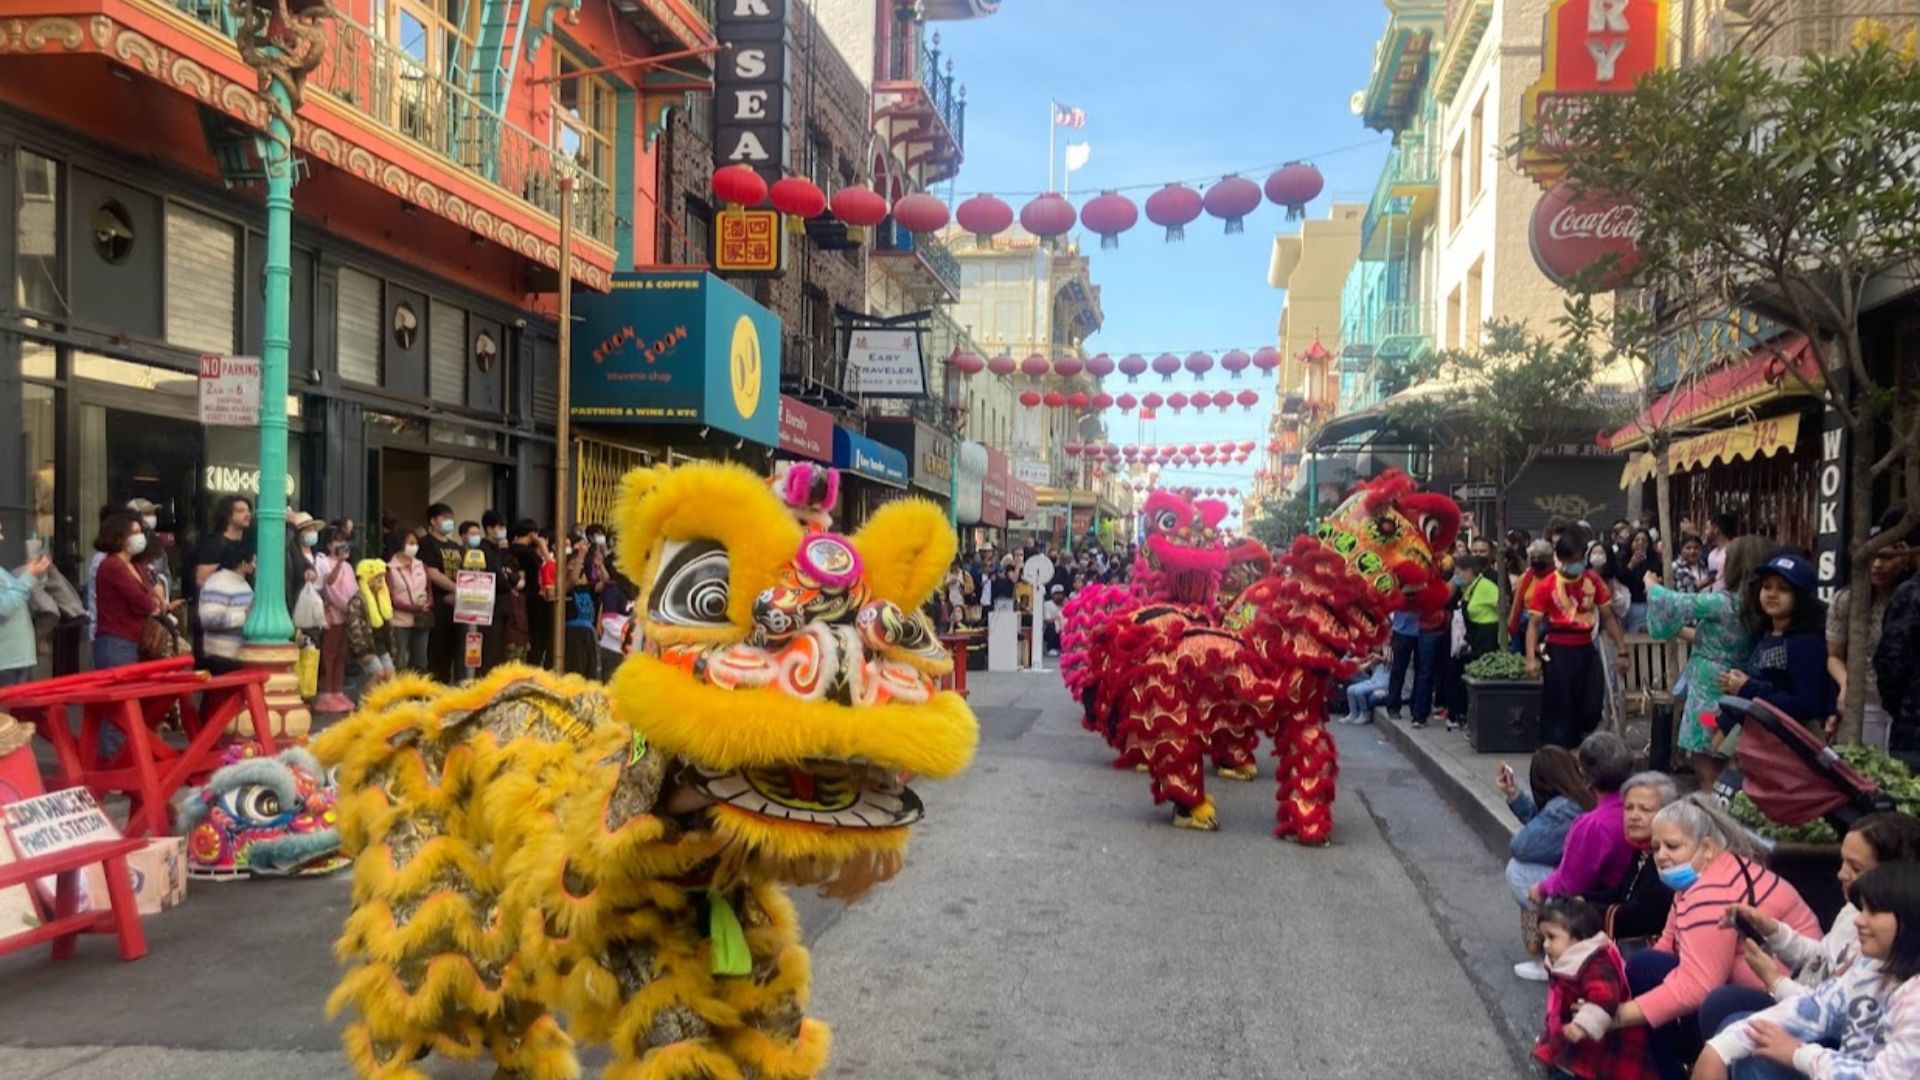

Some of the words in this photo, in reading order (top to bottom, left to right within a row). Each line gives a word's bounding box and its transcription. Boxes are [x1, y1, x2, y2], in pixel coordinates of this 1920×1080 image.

[1549, 204, 1642, 239] Coca-Cola
[656, 280, 699, 289] COFFEE
[592, 325, 635, 364] SOON
[644, 325, 687, 364] SOON
[202, 358, 219, 376] NO
[222, 362, 259, 378] PARKING
[649, 370, 672, 382] shop
[571, 407, 623, 417] PASTRIES
[636, 408, 665, 417] WINE
[677, 409, 698, 418] ETC
[1753, 421, 1778, 448] 720
[1820, 428, 1843, 534] WOK
[19, 825, 62, 857] PHOTO
[58, 810, 108, 840] STATION
